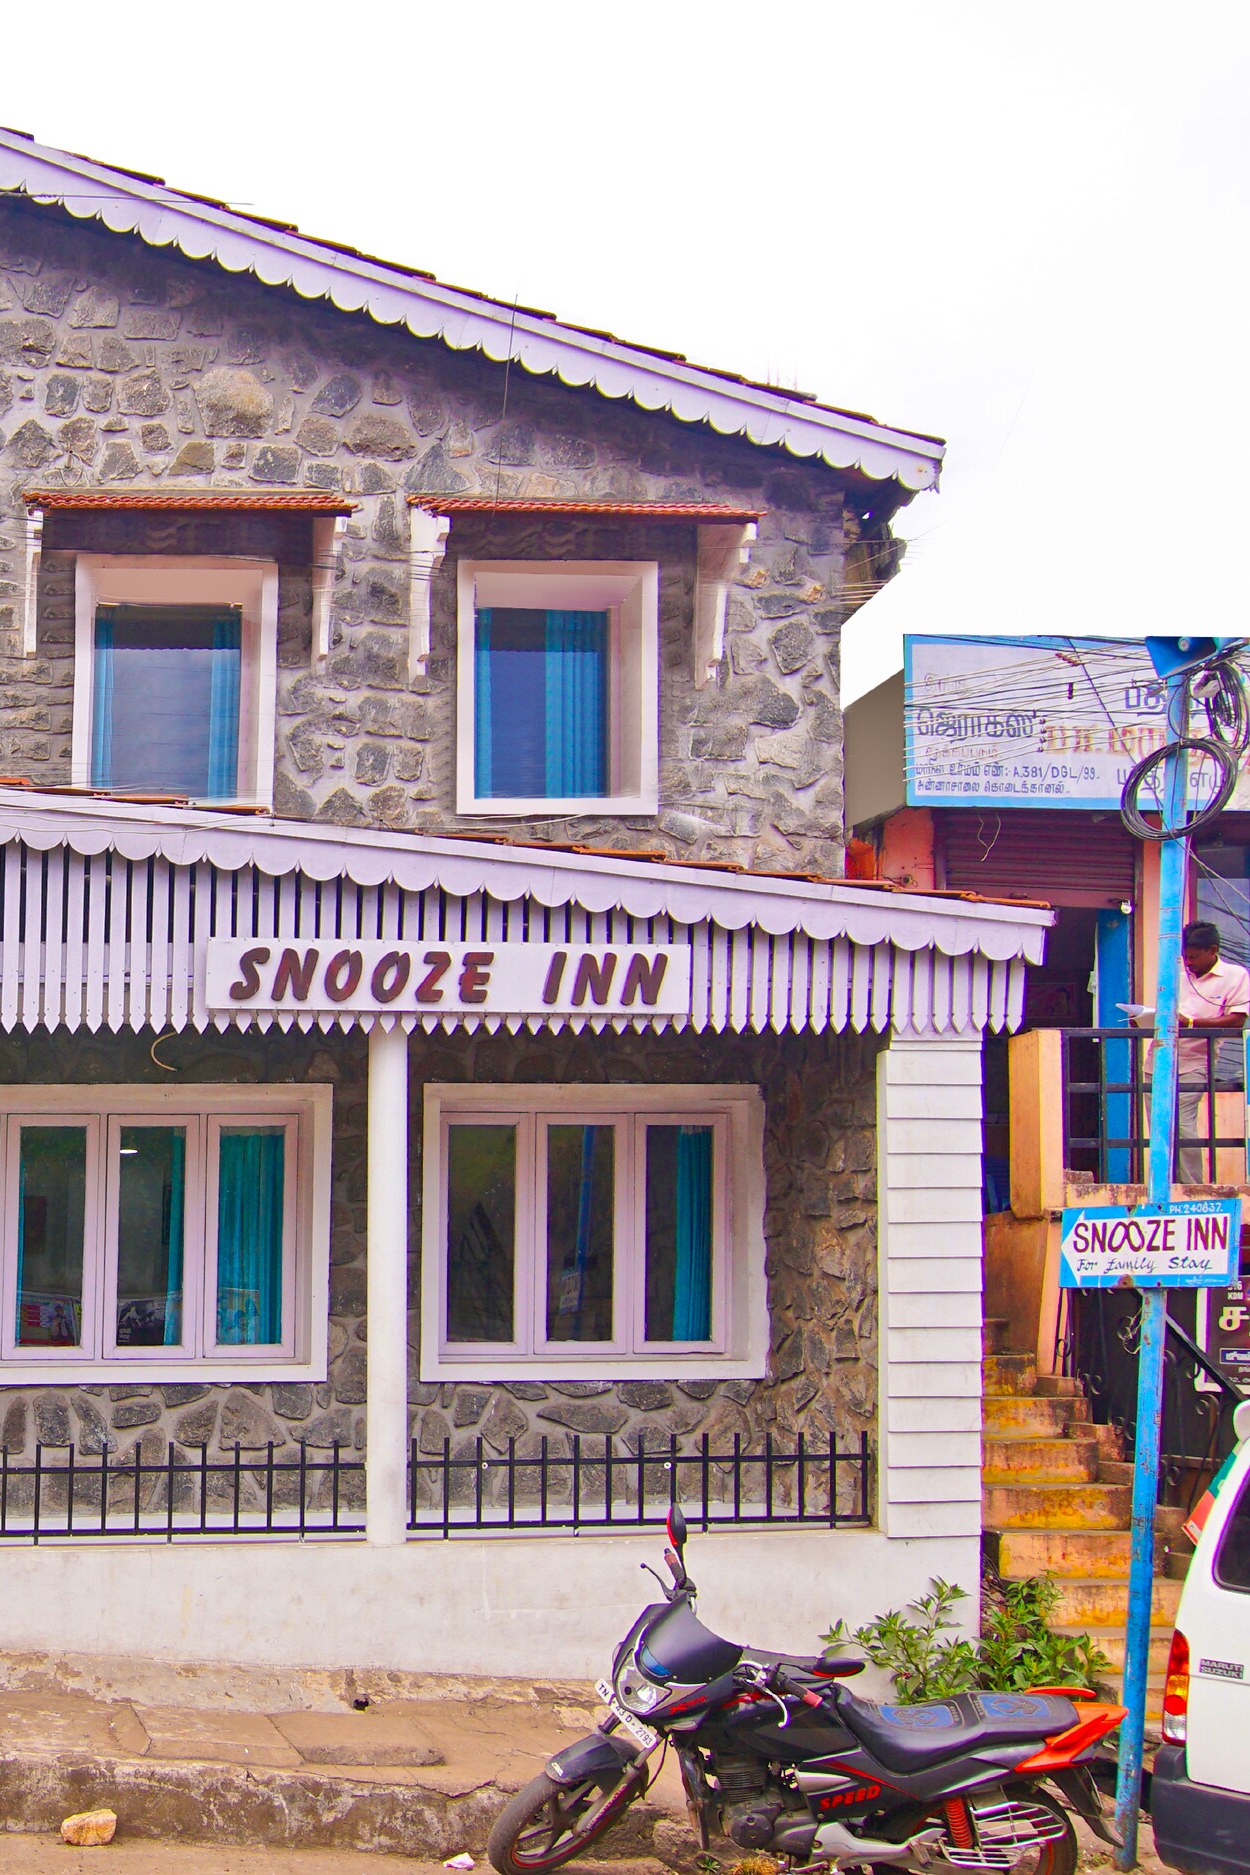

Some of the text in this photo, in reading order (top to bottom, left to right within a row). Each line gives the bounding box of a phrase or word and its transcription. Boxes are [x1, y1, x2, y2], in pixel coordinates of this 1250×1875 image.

[229, 946, 669, 1006] SNOOZE INN
[1073, 1216, 1228, 1253] SNOOZE INN
[1077, 1259, 1097, 1271] For
[1168, 1256, 1212, 1272] Stay
[1201, 1660, 1243, 1671] MARUTI
[1201, 1666, 1243, 1678] SUZUKI
[598, 1683, 610, 1697] TN
[818, 1784, 881, 1811] SPEED
